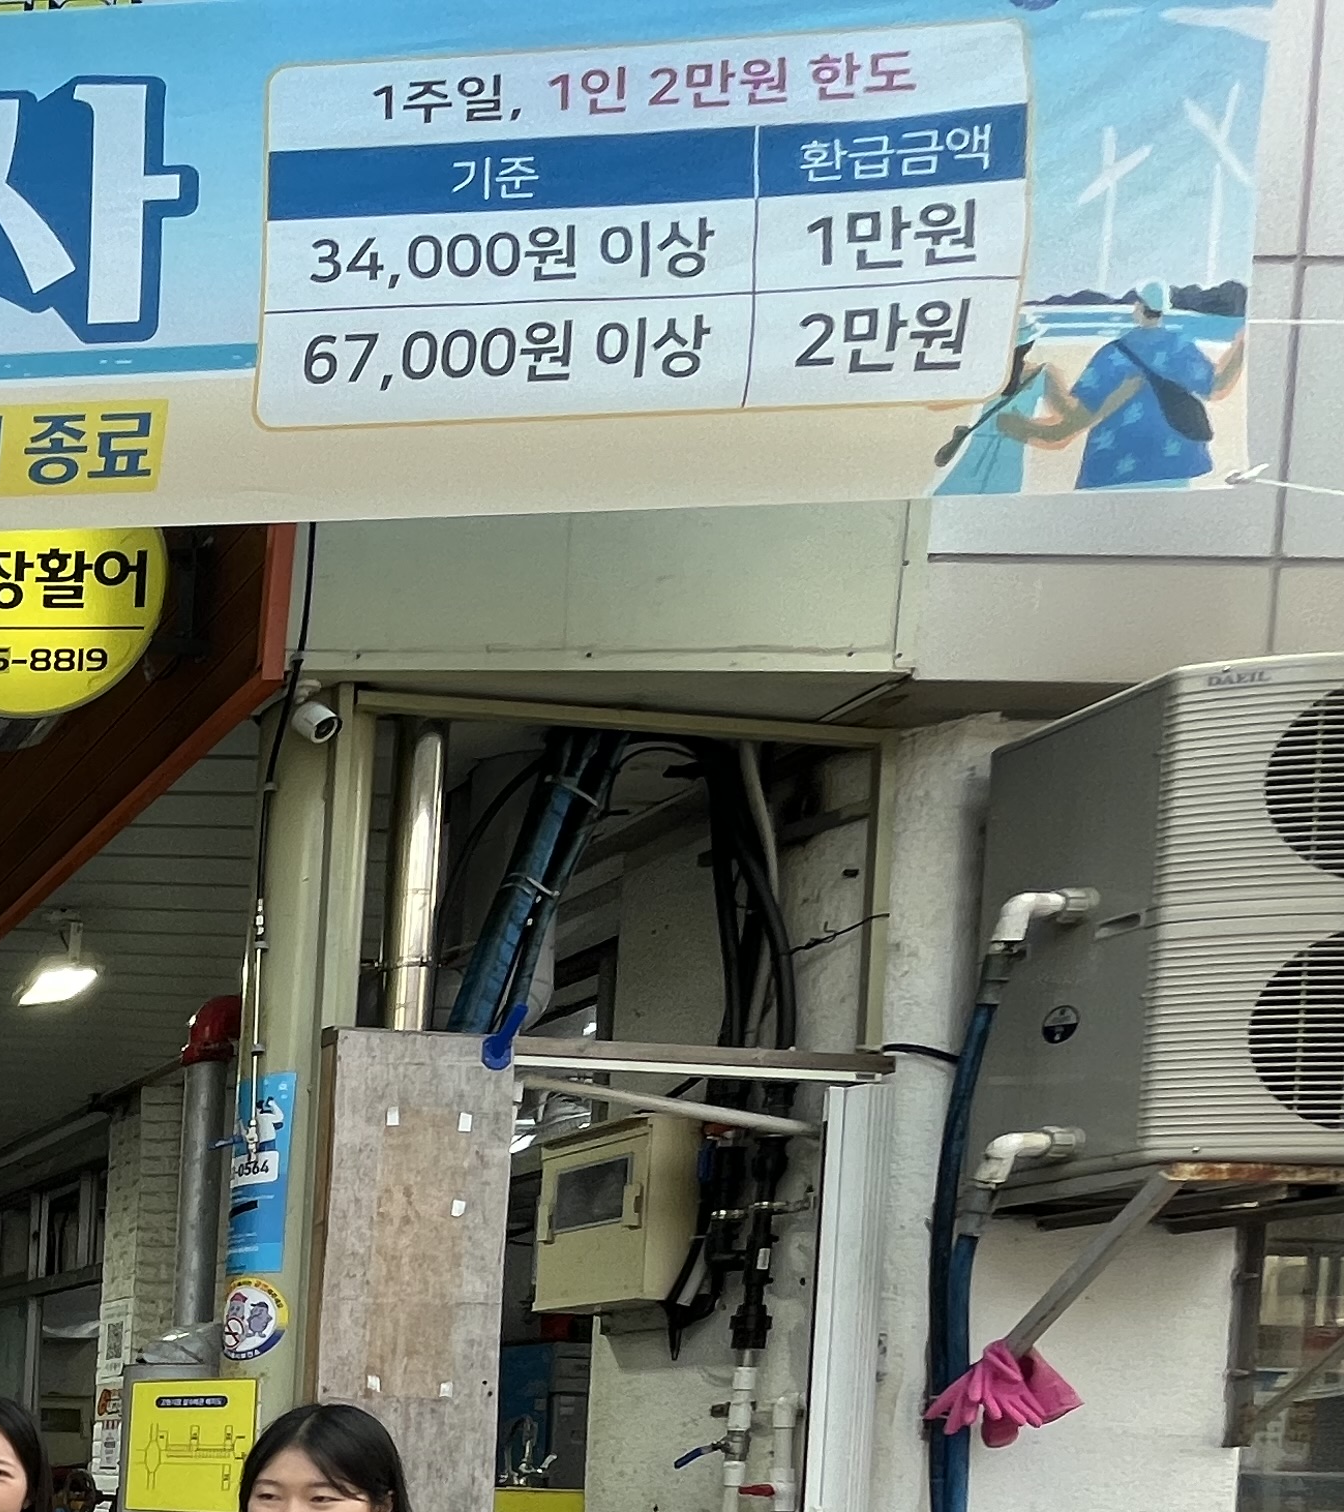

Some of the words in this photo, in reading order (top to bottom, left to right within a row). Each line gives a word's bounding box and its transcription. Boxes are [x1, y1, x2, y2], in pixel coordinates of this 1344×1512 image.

[372, 73, 522, 124] 1주일,
[548, 66, 627, 117] 1인
[648, 56, 789, 111] 2만원
[809, 49, 917, 101] 한도
[451, 154, 540, 201] 기준
[799, 123, 993, 184] 환급금액
[310, 224, 578, 291] 34,000원
[600, 216, 716, 279] 이상
[806, 198, 979, 271] 1만원
[303, 318, 573, 392] 67,000원
[596, 314, 712, 379] 이상
[795, 298, 972, 373] 2만원
[24, 409, 152, 486] 종료
